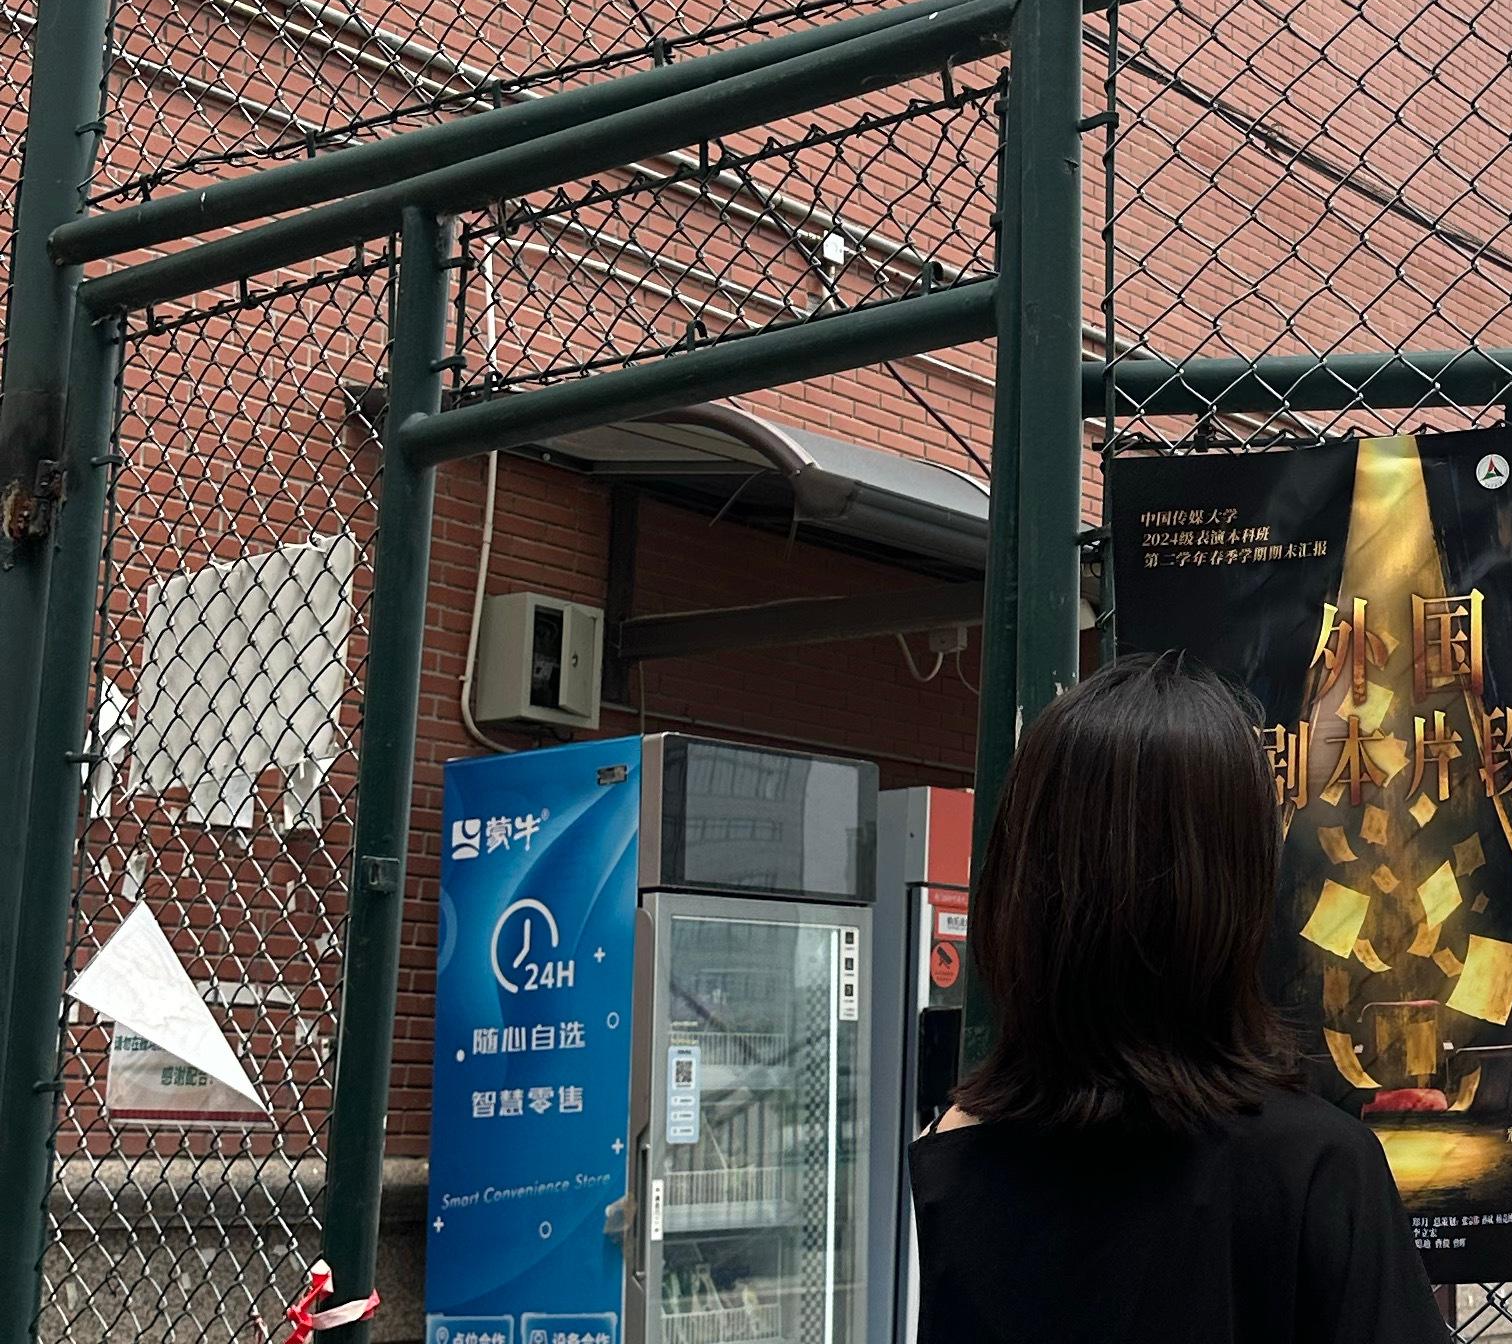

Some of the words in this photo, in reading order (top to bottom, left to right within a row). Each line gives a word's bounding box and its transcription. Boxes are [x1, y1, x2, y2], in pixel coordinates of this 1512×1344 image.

[1140, 507, 1239, 528] 中国传媒大学
[1141, 524, 1271, 548] 2024级表演本科班
[1309, 587, 1485, 706] 外国
[485, 812, 541, 855] 蒙牛
[523, 959, 576, 992] 24H
[471, 1020, 587, 1056] 随心自选
[471, 1085, 585, 1119] 智慧零售
[441, 1192, 480, 1211] Smart
[483, 1180, 570, 1204] Convenience
[574, 1173, 611, 1190] Store
